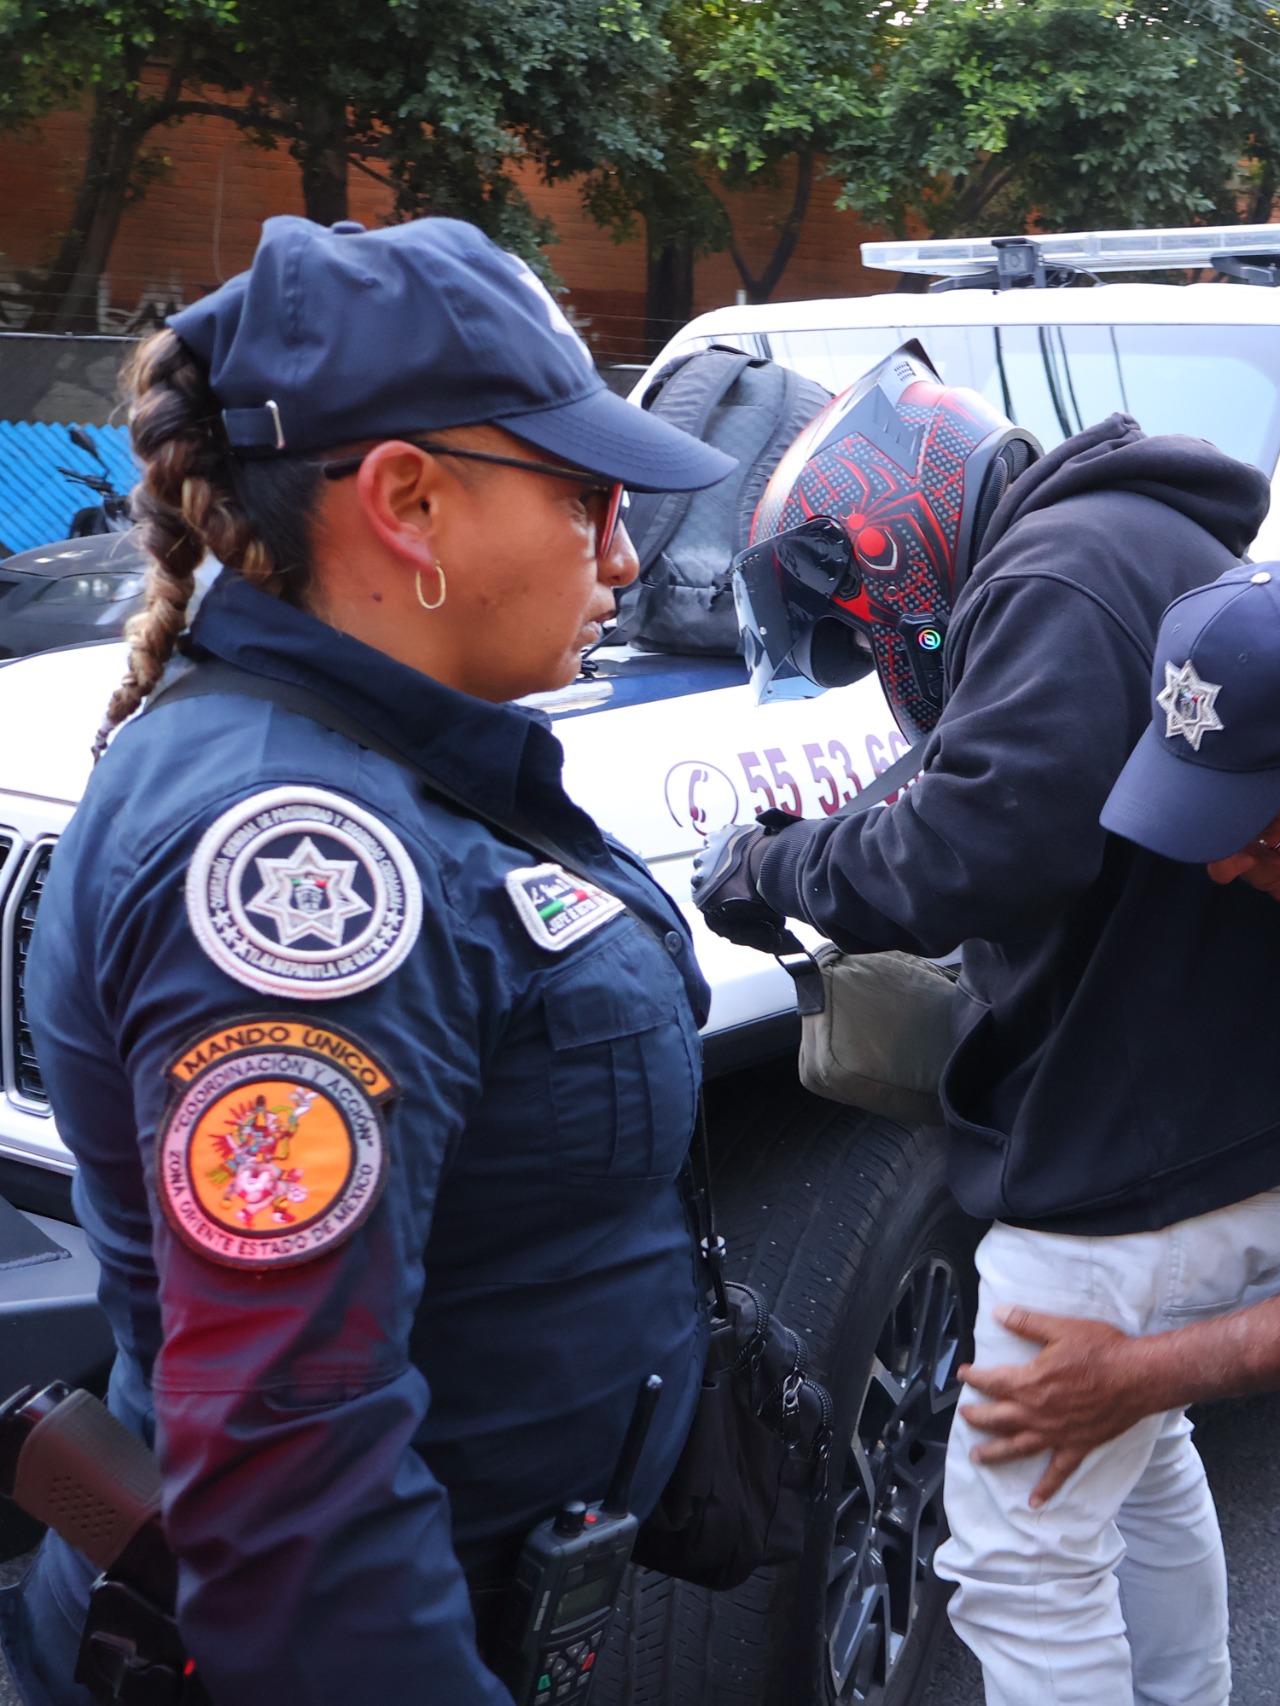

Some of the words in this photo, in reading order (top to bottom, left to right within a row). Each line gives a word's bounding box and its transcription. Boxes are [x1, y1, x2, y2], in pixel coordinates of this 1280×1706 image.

[737, 747, 802, 817] 55
[802, 740, 862, 816] 53
[183, 1026, 291, 1075] MANDO
[313, 1064, 327, 1080] Y
[169, 1151, 185, 1197] ZONA
[181, 1201, 235, 1251] ORIENTE
[239, 1235, 306, 1255] ESTADO
[311, 1219, 335, 1242] DE
